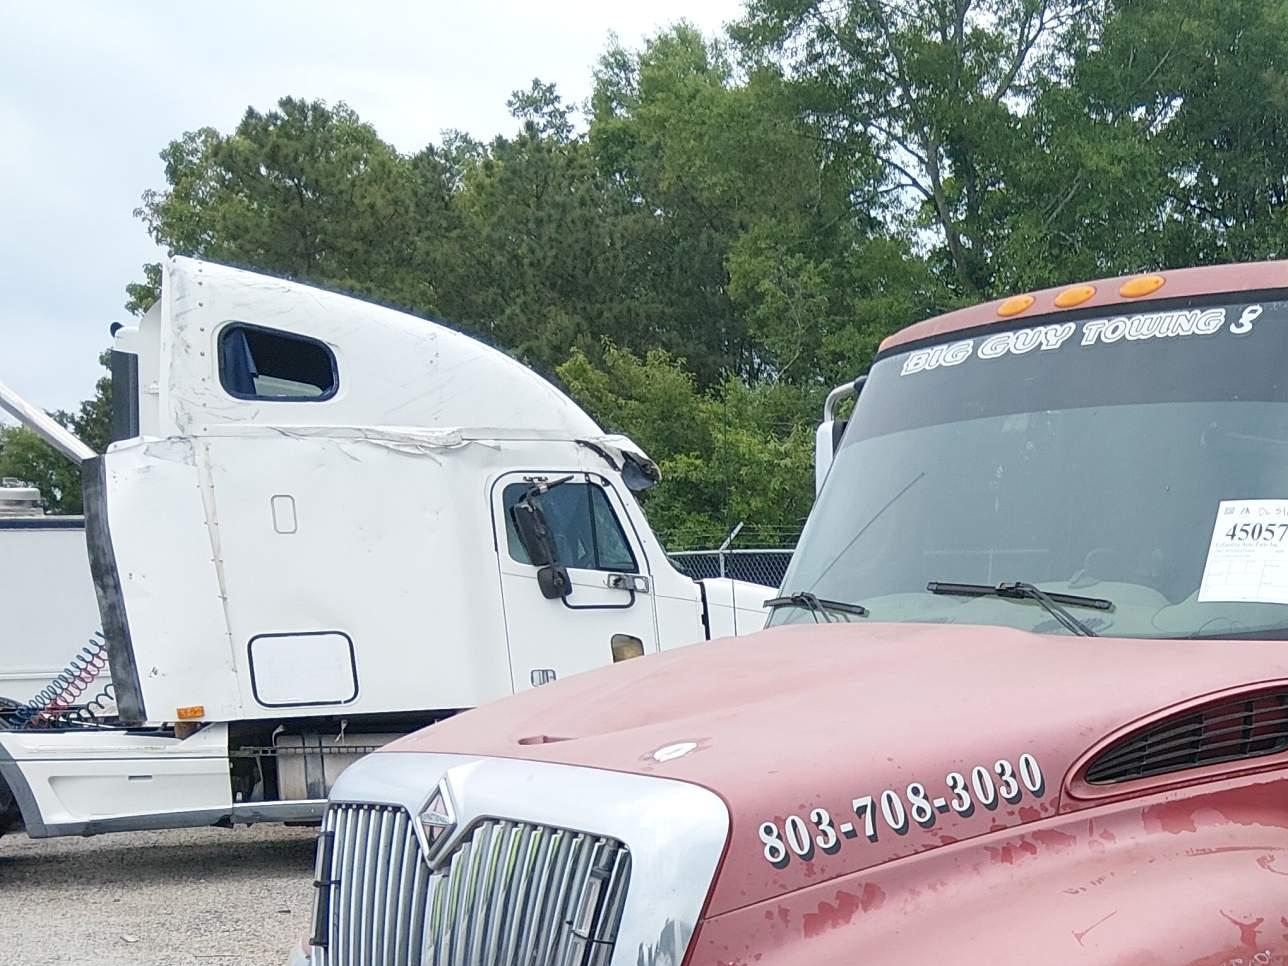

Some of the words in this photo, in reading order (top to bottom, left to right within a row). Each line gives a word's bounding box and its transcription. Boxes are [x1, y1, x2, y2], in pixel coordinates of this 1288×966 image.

[900, 340, 974, 376] BIG
[977, 322, 1076, 360] GUY
[1081, 308, 1226, 346] TOWING
[757, 752, 1046, 869] 803-708-3030
